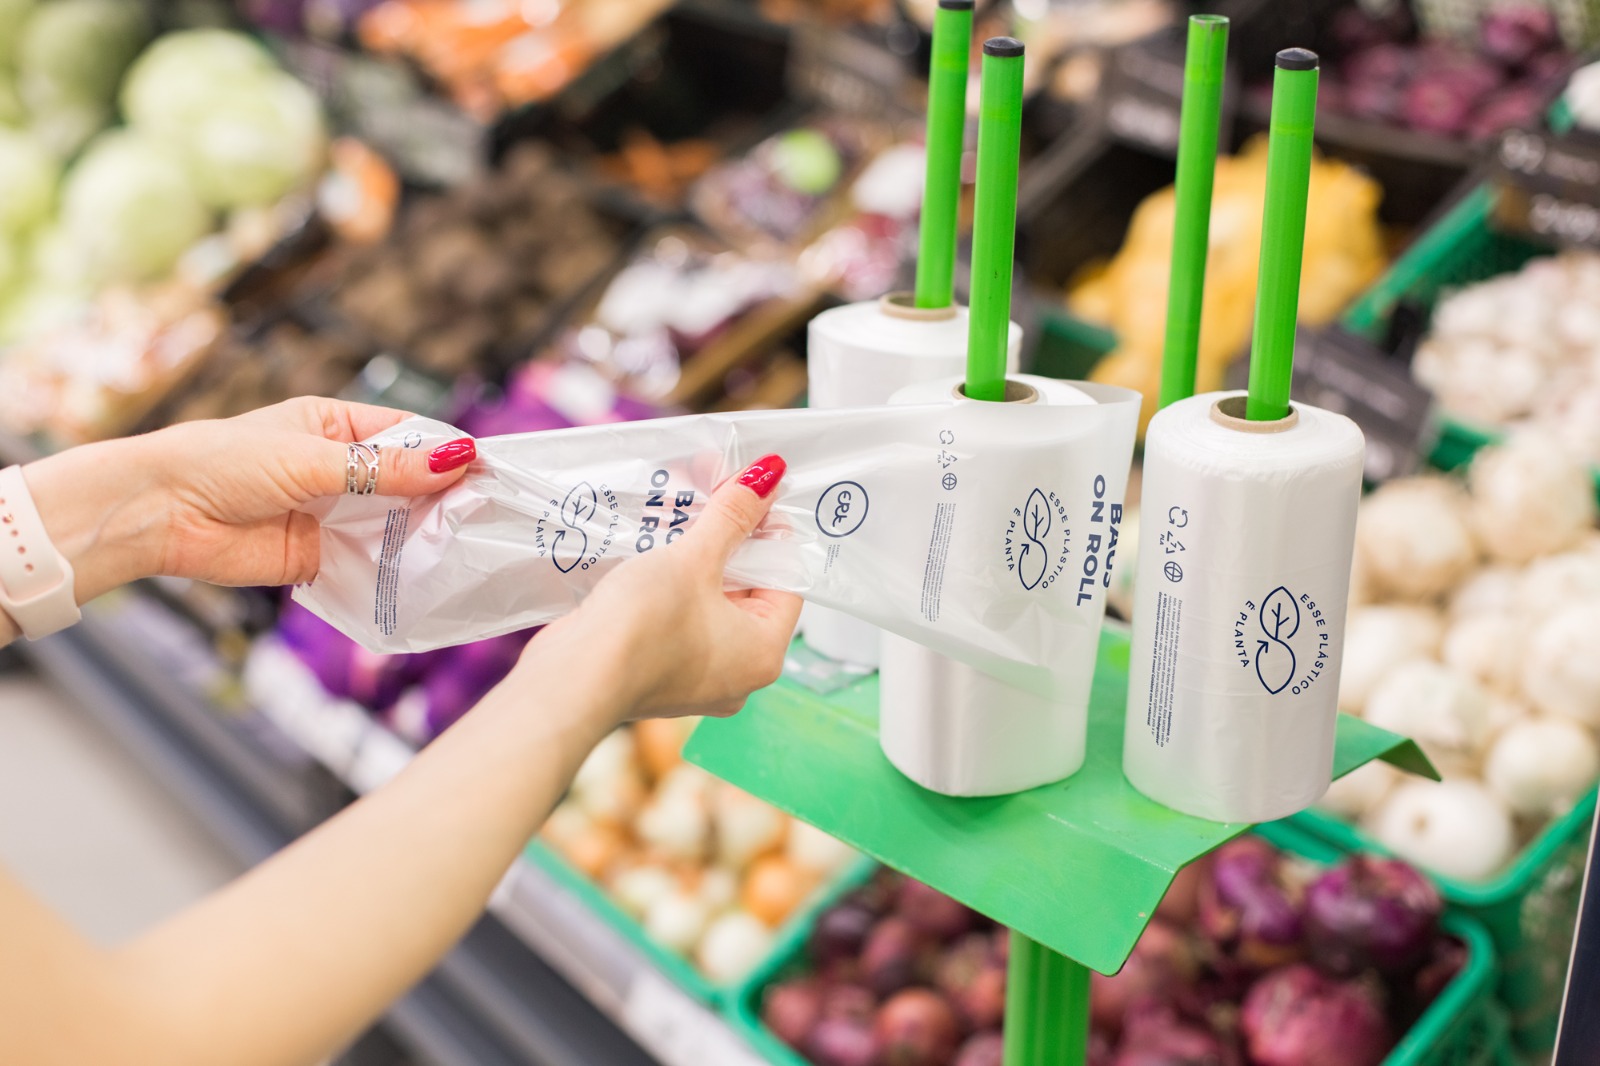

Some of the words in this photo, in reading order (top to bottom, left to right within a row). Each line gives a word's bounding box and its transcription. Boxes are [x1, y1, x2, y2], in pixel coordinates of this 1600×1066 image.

[599, 483, 619, 509] ESSE
[645, 469, 670, 507] ON
[1049, 492, 1068, 523] ESSE
[1090, 474, 1105, 522] ON
[535, 511, 550, 557] PLANTA
[635, 516, 661, 554] RO
[666, 490, 695, 545] BAG
[1004, 521, 1016, 571] PLANTA
[1041, 529, 1071, 589] PLÁSTICO
[1076, 534, 1102, 607] ROLL
[1300, 593, 1326, 626] ESSE
[1234, 611, 1250, 668] PLANTA
[1292, 633, 1329, 695] PLÁSTICO
